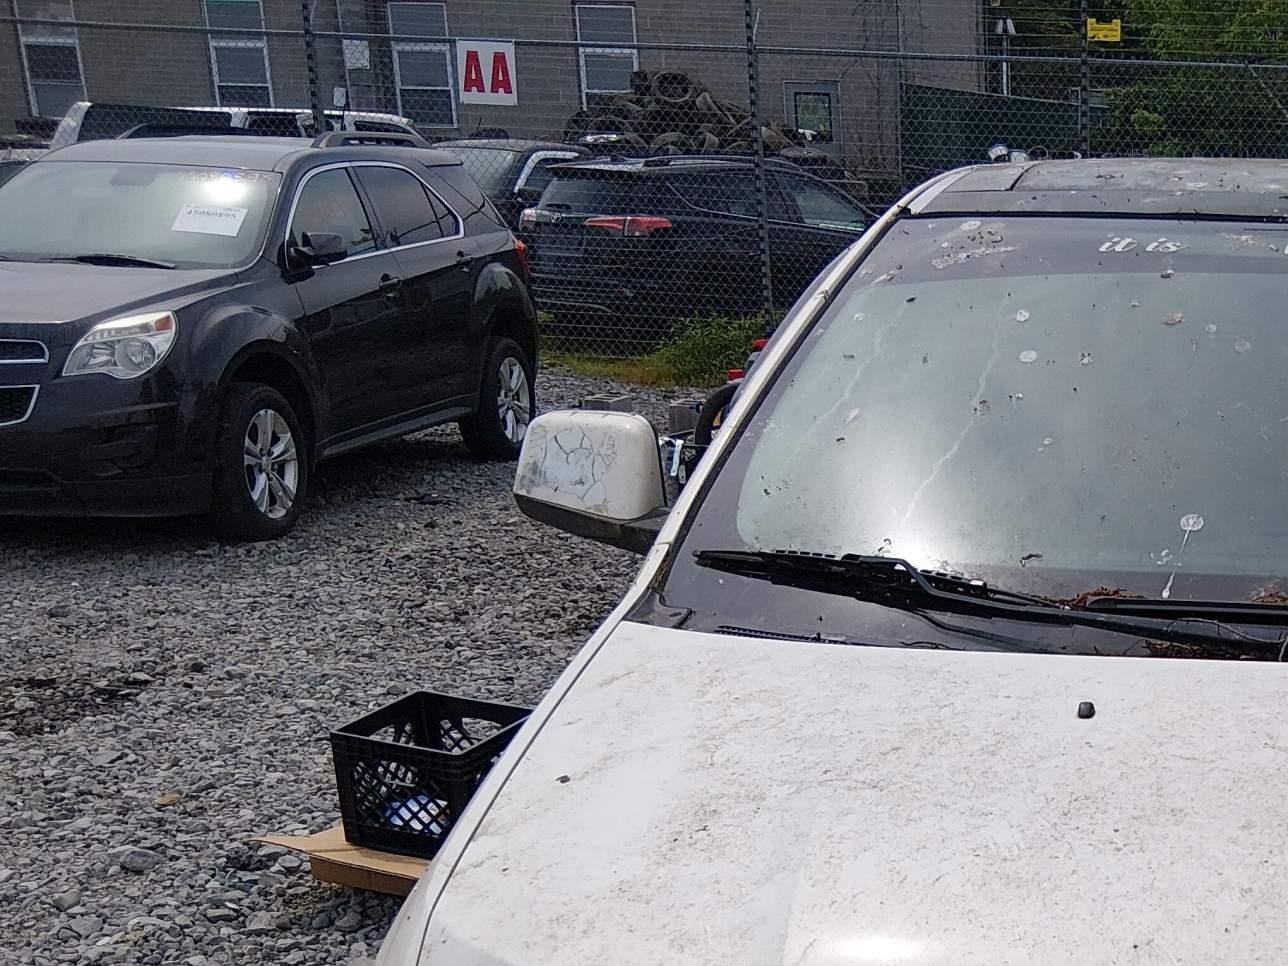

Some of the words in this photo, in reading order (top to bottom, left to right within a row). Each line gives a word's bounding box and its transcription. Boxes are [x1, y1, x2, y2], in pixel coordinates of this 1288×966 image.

[463, 50, 513, 94] AA
[1099, 237, 1137, 252] it
[1146, 237, 1187, 252] is
